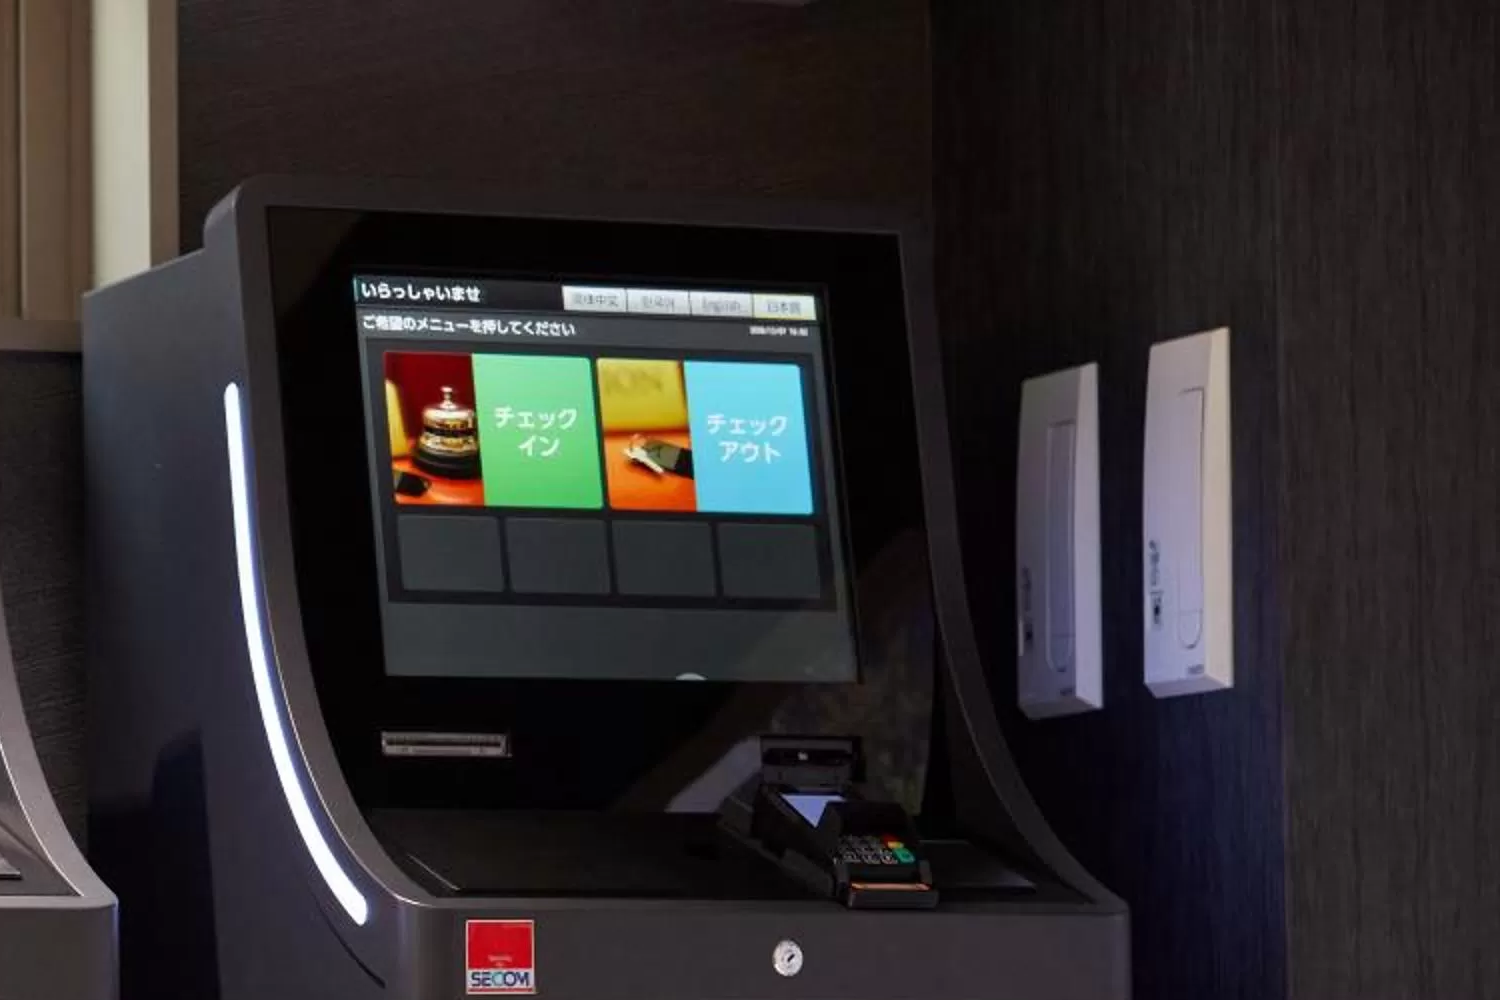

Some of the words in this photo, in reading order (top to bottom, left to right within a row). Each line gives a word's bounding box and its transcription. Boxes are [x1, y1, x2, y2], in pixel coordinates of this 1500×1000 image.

[361, 282, 481, 303] いらっしゃいませ
[363, 314, 576, 337] ご希望のメニューを押してください
[493, 405, 578, 429] チェック
[706, 412, 788, 436] チェック
[517, 435, 560, 458] イン
[718, 439, 782, 463] アウト
[471, 971, 529, 987] SECOM
